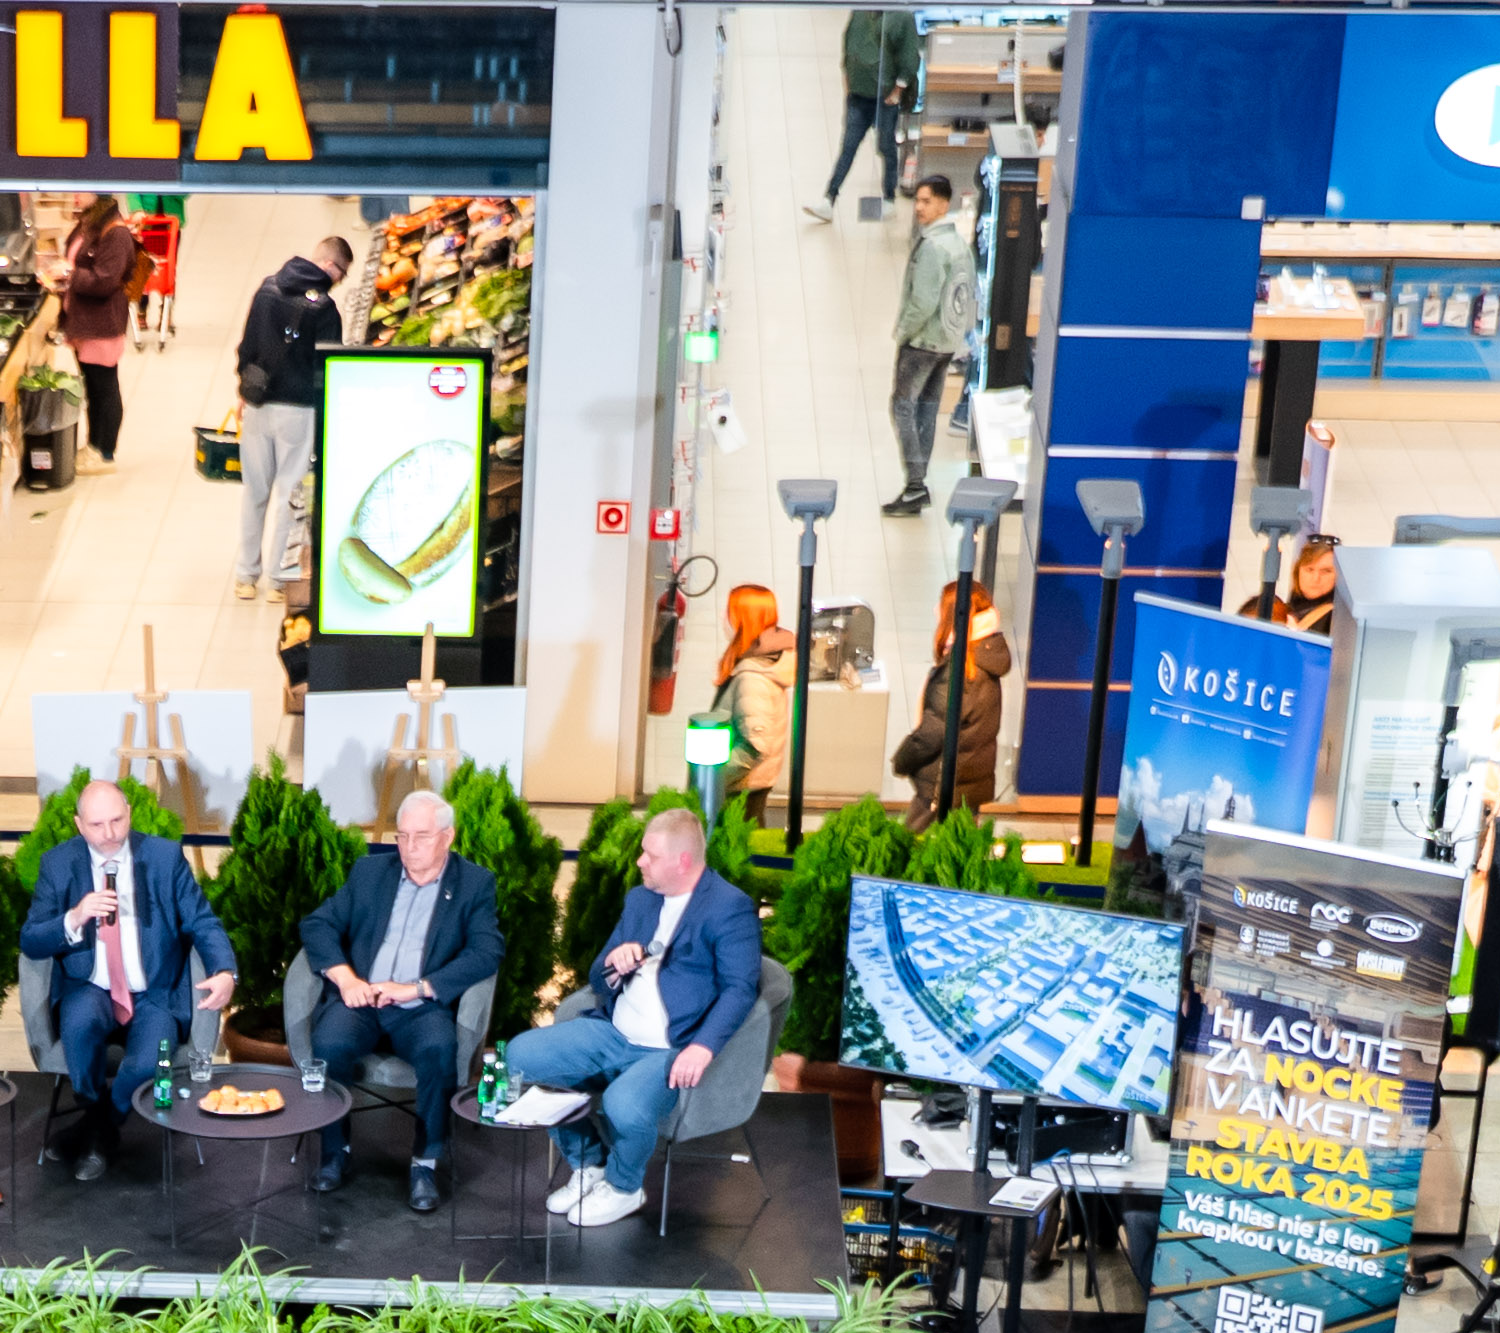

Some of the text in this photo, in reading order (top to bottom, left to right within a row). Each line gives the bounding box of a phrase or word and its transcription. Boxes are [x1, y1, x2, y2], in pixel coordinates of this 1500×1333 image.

[1183, 665, 1298, 718] KOŠICE
[1246, 890, 1300, 915] KOŠICE
[1212, 1005, 1403, 1075] HLASUJTE
[1205, 1039, 1405, 1112] ZA NOCKE
[1207, 1077, 1392, 1147] V ANKETE
[1216, 1117, 1370, 1180] STAVBA
[1186, 1145, 1395, 1221] ROKA 2025
[1177, 1211, 1383, 1279] kvapkou v bazéne.
[1184, 1190, 1381, 1255] Váš hlas nie je len
